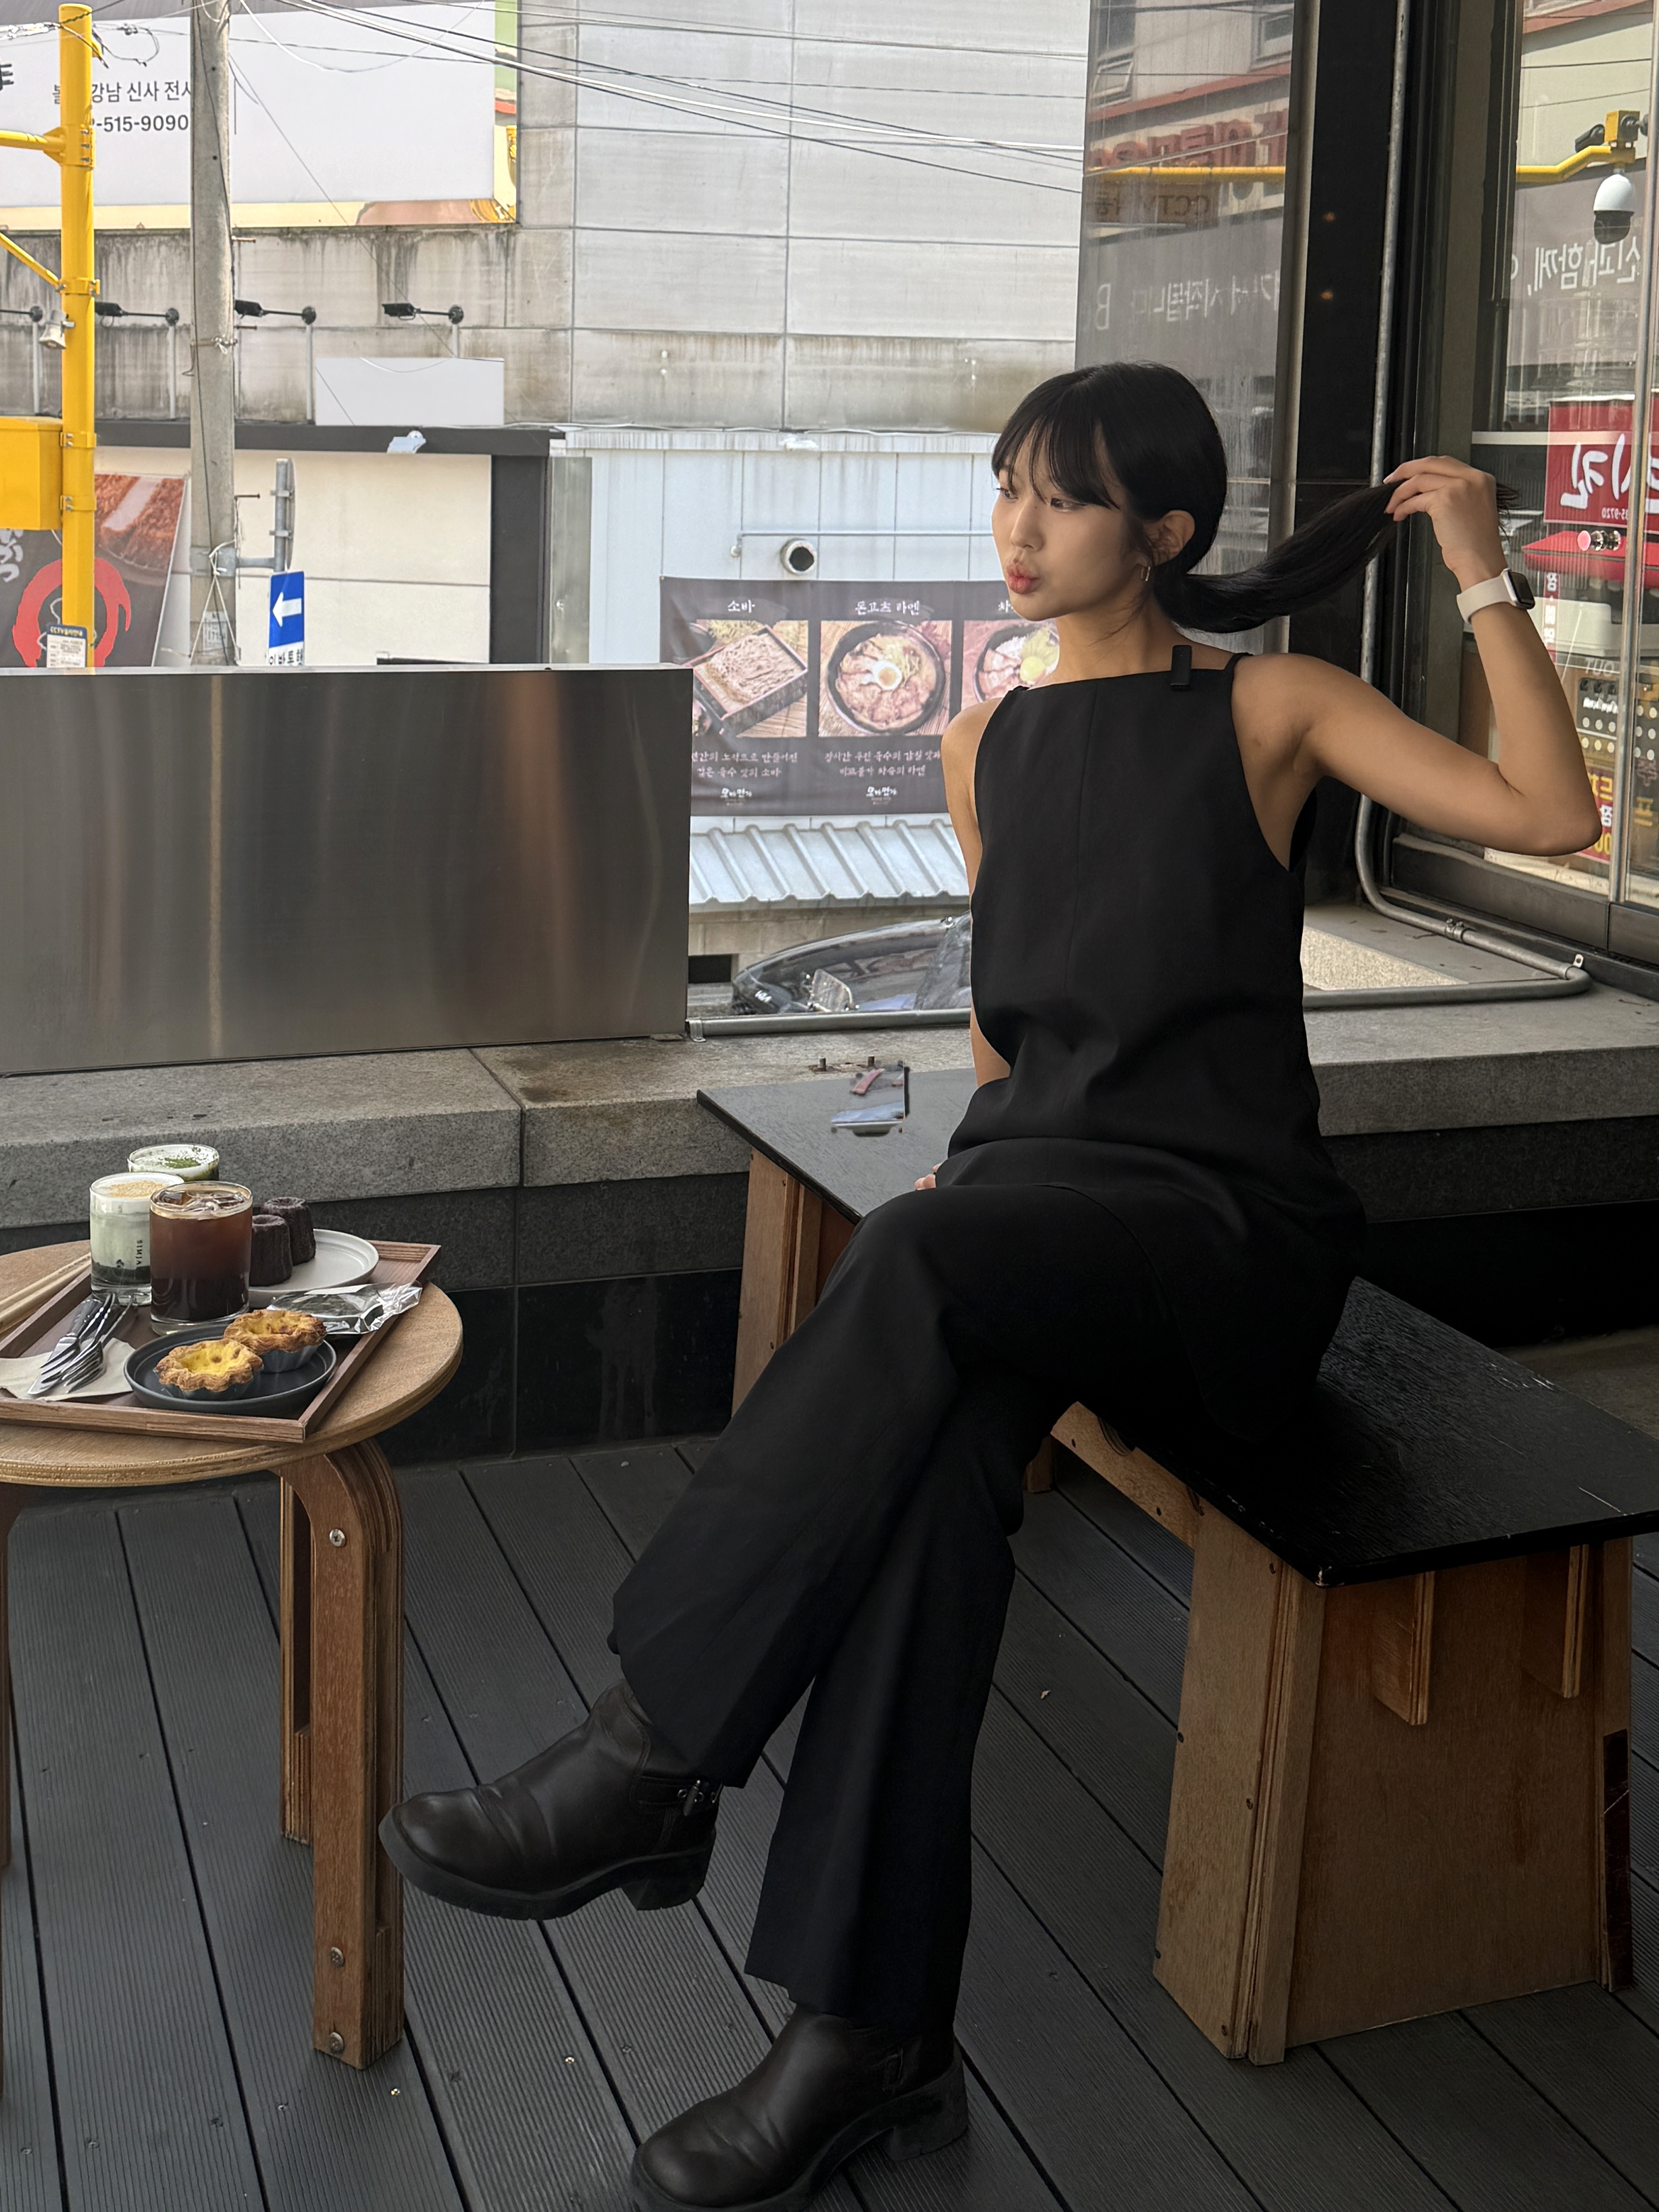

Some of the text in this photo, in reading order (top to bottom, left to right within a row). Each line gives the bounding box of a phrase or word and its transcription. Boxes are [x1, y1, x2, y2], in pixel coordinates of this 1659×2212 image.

[92, 82, 121, 103] 강남
[127, 80, 159, 102] 신사
[91, 115, 189, 132] -515-9090
[727, 599, 755, 613] 소바
